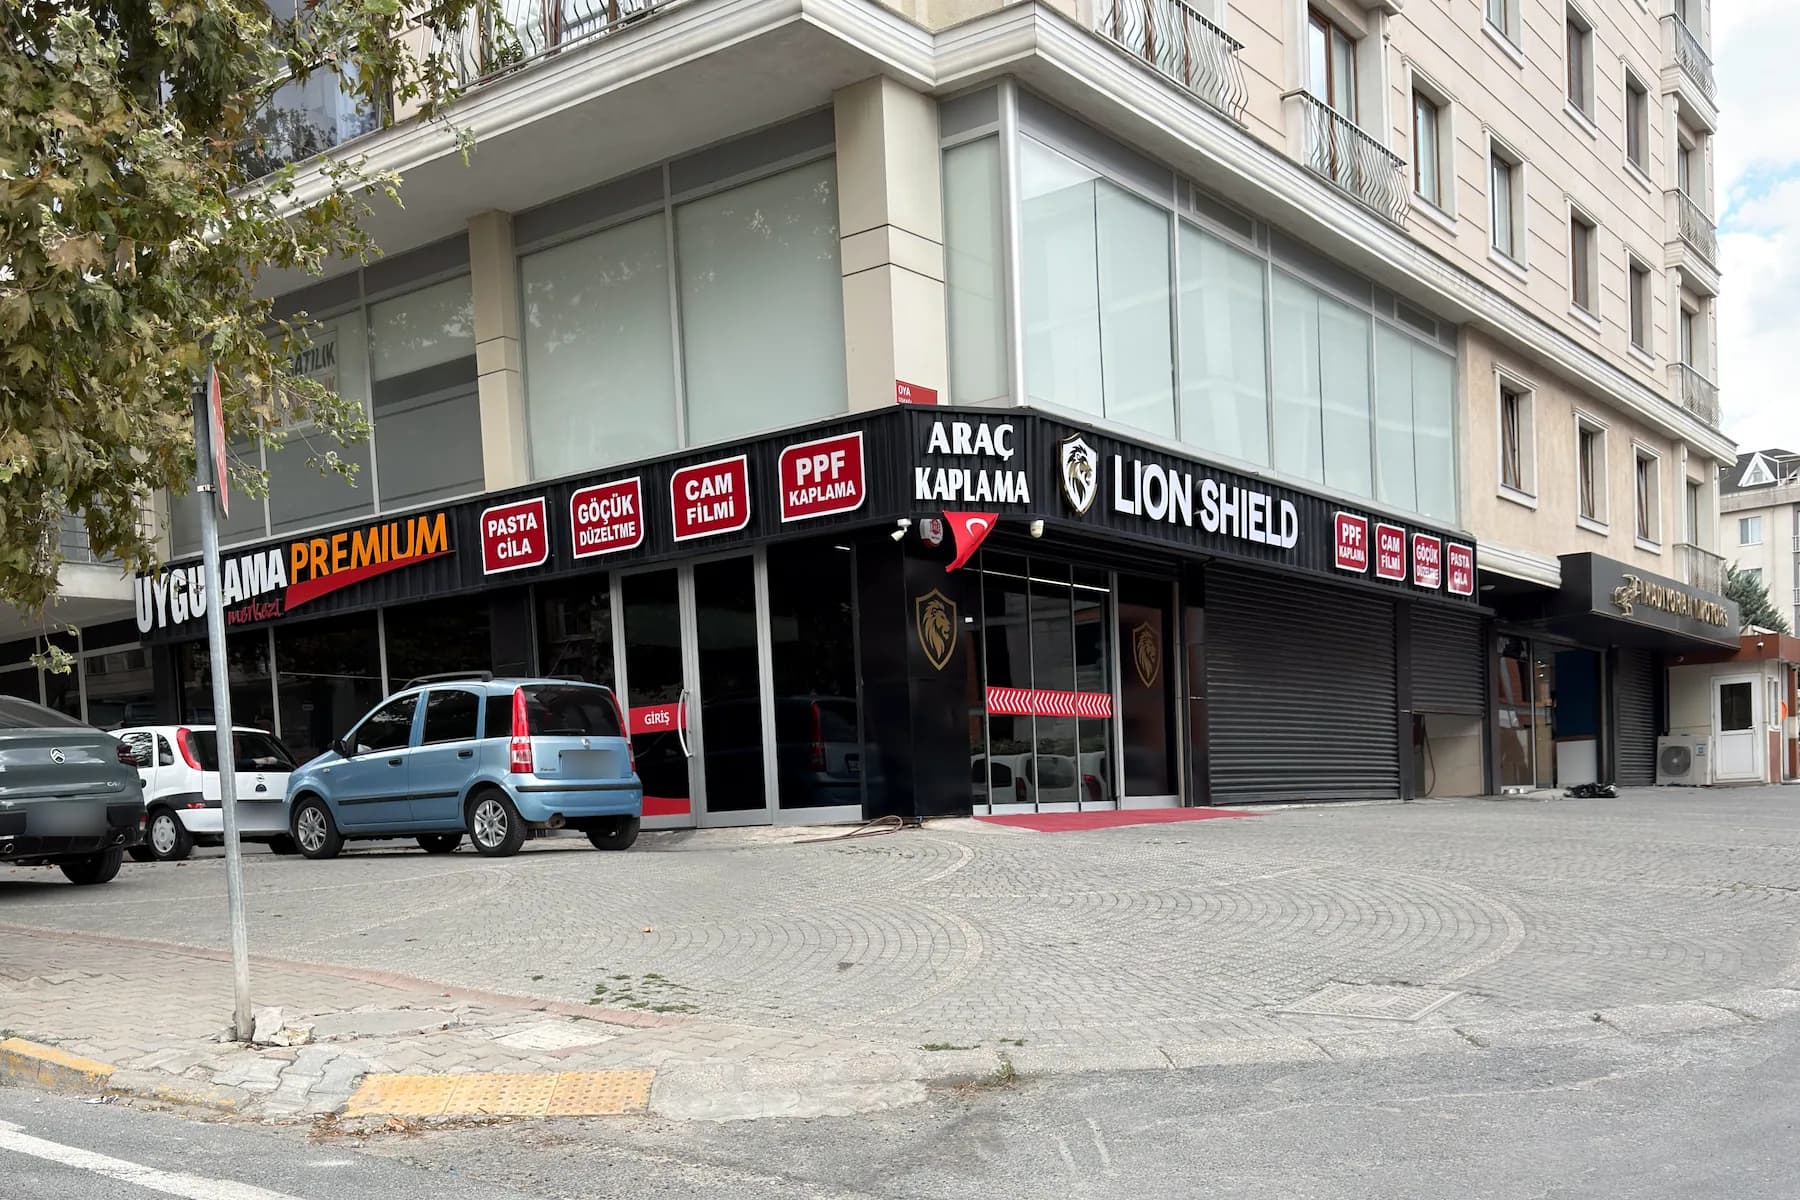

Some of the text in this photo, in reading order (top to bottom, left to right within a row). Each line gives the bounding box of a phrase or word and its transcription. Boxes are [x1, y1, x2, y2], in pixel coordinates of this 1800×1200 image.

[898, 385, 911, 396] OYA
[927, 421, 1014, 461] ARAÇ
[796, 450, 846, 486] PPF
[685, 472, 733, 501] CAM
[789, 480, 856, 507] KAPLAMA
[915, 467, 1030, 504] KAPLAMA
[578, 492, 634, 525] GÖÇÜK
[686, 496, 735, 525] FİLMİ
[1114, 454, 1299, 549] LION SHIELD
[488, 512, 538, 538] PASTA
[580, 521, 636, 547] DÜZELTME
[1342, 523, 1362, 547] PPF
[497, 537, 532, 559] CİLA
[1339, 545, 1365, 562] KAPLAMA
[1381, 534, 1400, 553] CAM
[134, 512, 449, 633] UYGUAMA PREMIUM
[1381, 551, 1401, 571] FİLMİ
[1450, 552, 1470, 569] PASTA
[644, 710, 670, 726] GİRİŞ
